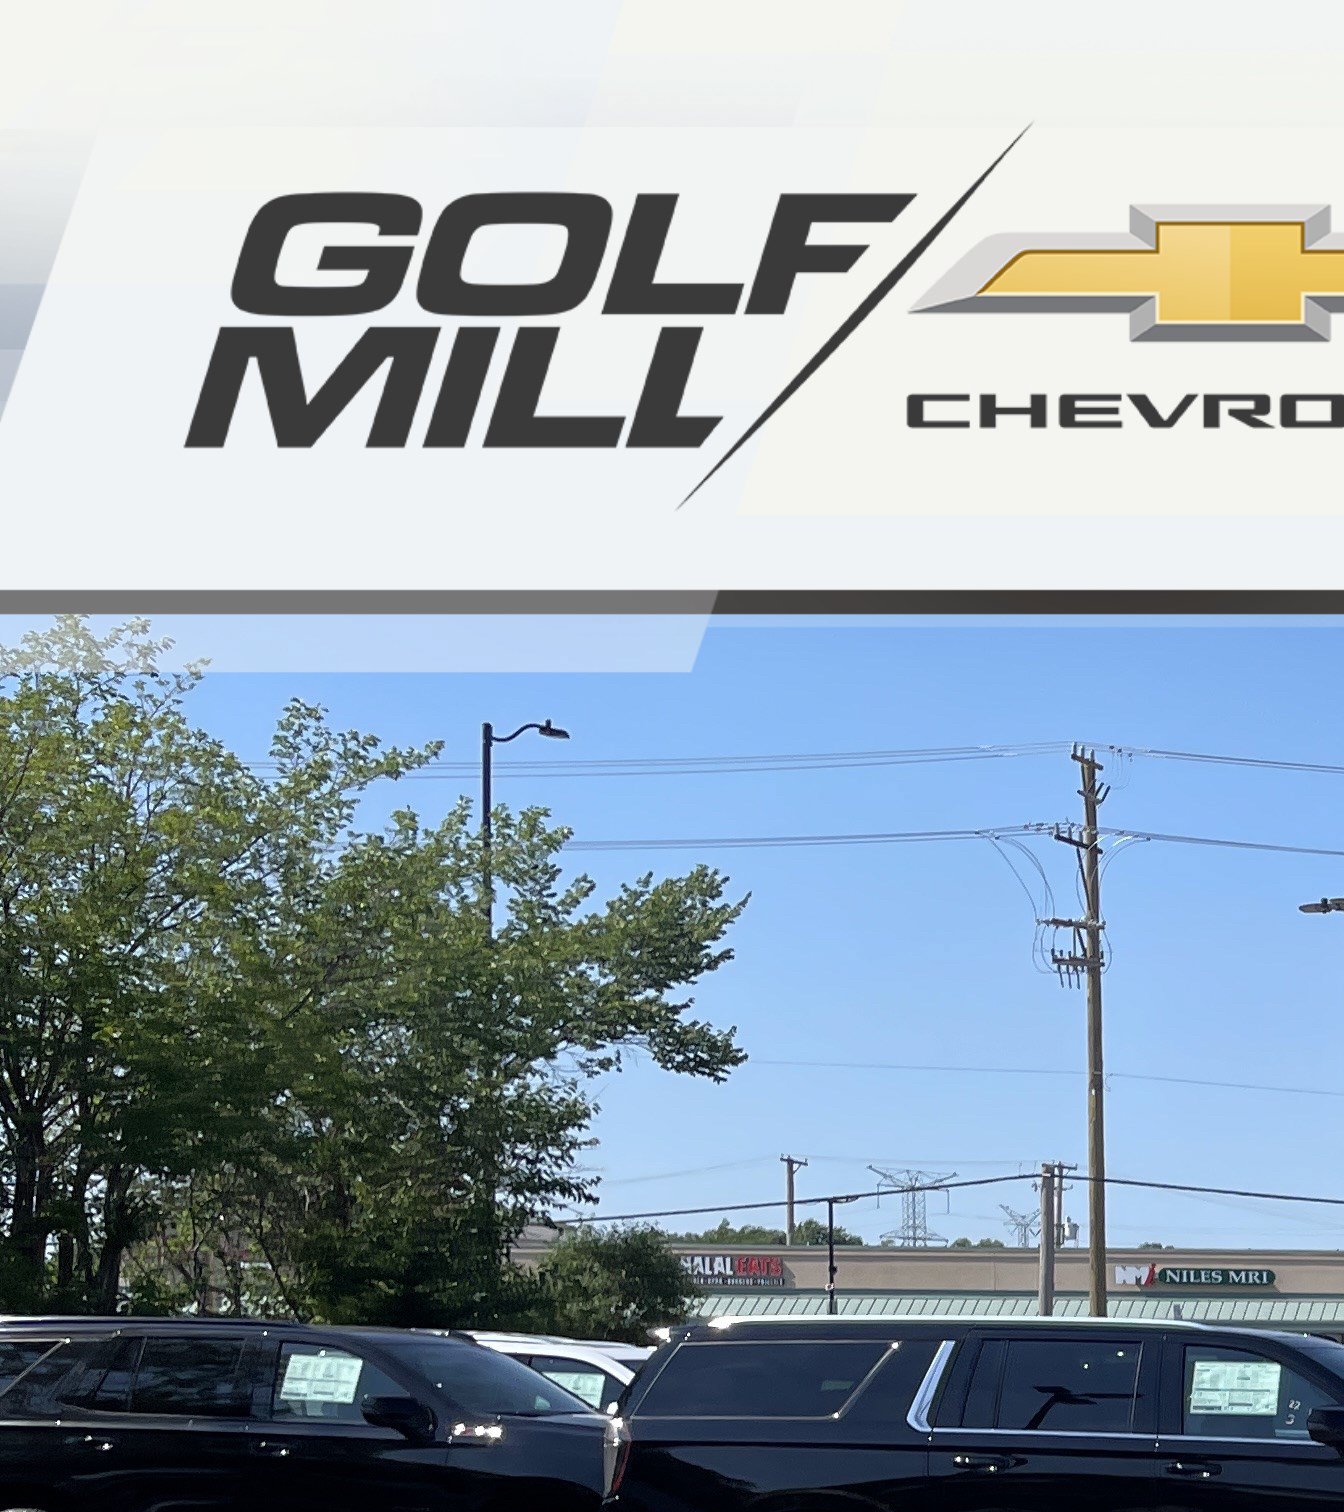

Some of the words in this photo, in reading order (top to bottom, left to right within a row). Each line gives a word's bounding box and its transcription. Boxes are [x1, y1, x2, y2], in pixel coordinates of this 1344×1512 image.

[680, 1256, 733, 1276] HALAL
[735, 1256, 782, 1276] EATS
[1166, 1269, 1222, 1283] NILES
[1228, 1270, 1268, 1284] MRI
